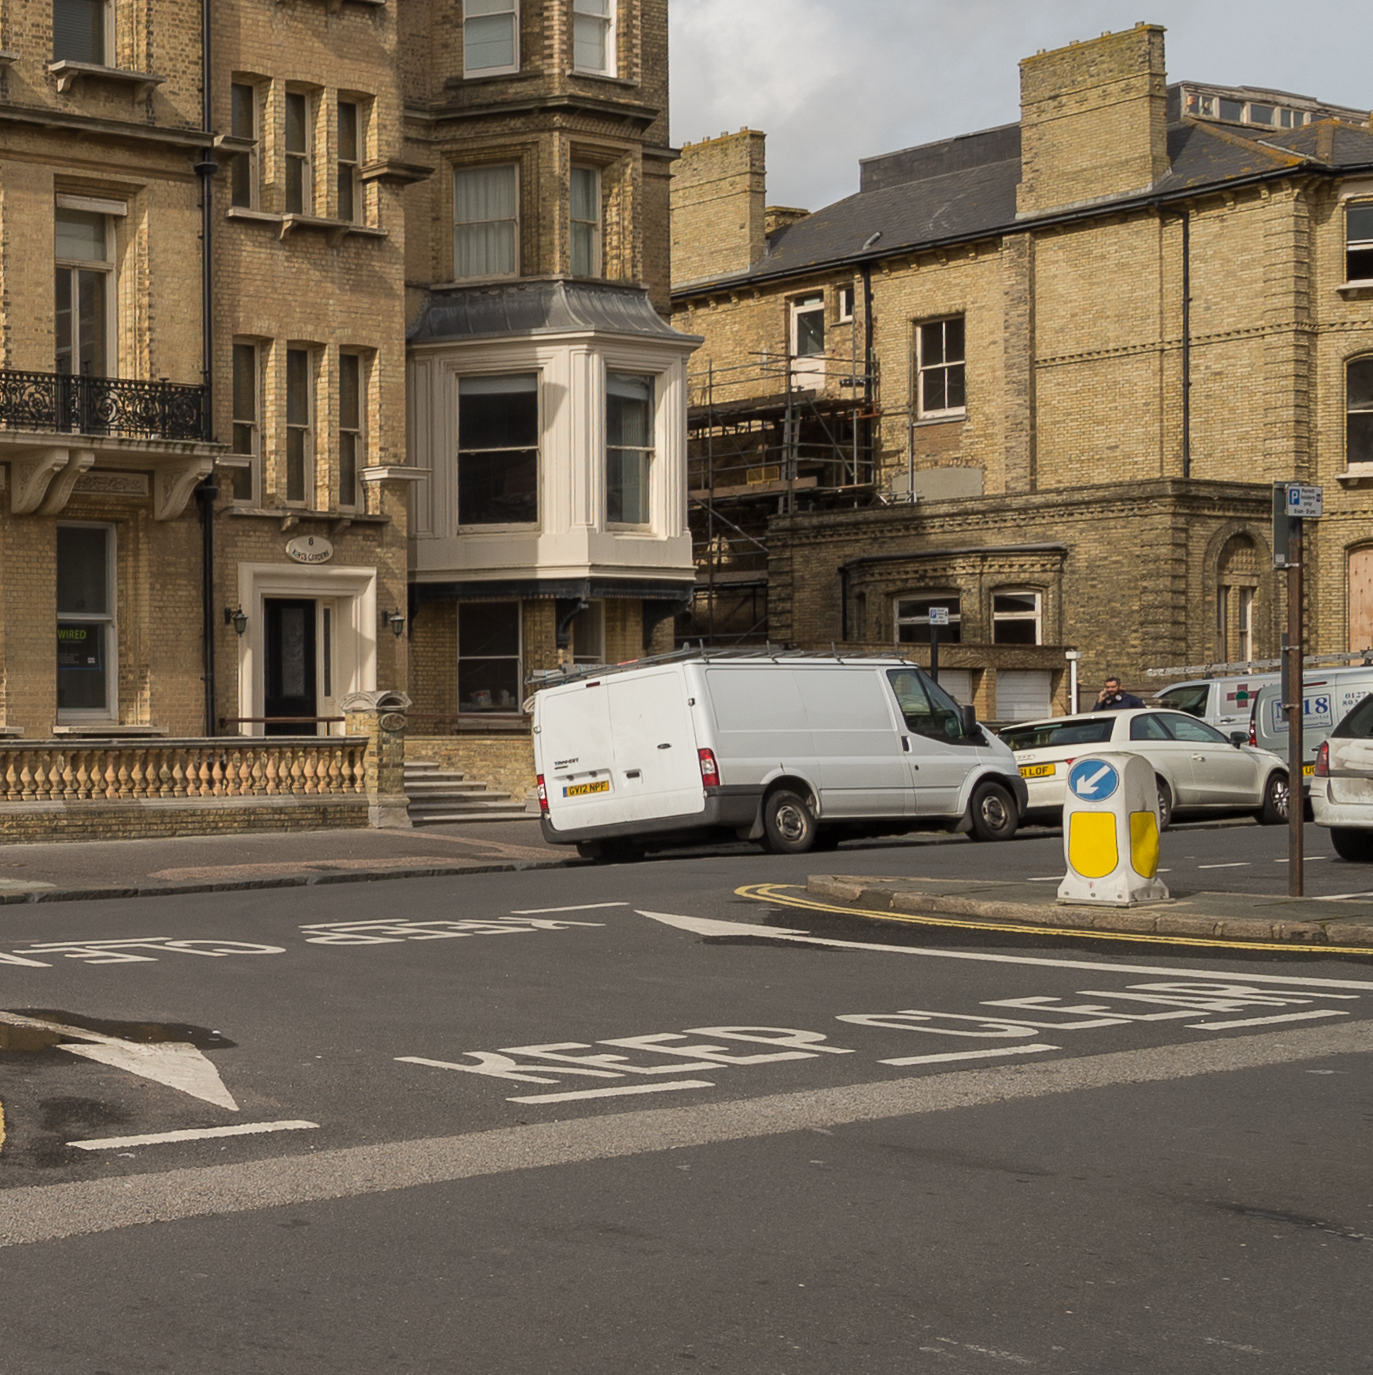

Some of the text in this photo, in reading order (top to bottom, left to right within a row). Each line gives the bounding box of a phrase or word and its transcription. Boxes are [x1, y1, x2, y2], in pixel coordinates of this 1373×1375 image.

[58, 629, 87, 640] WIRED
[1029, 766, 1049, 775] LOF
[569, 781, 606, 796] GV12 NPF
[393, 981, 1361, 1084] KEEP CLEAR
